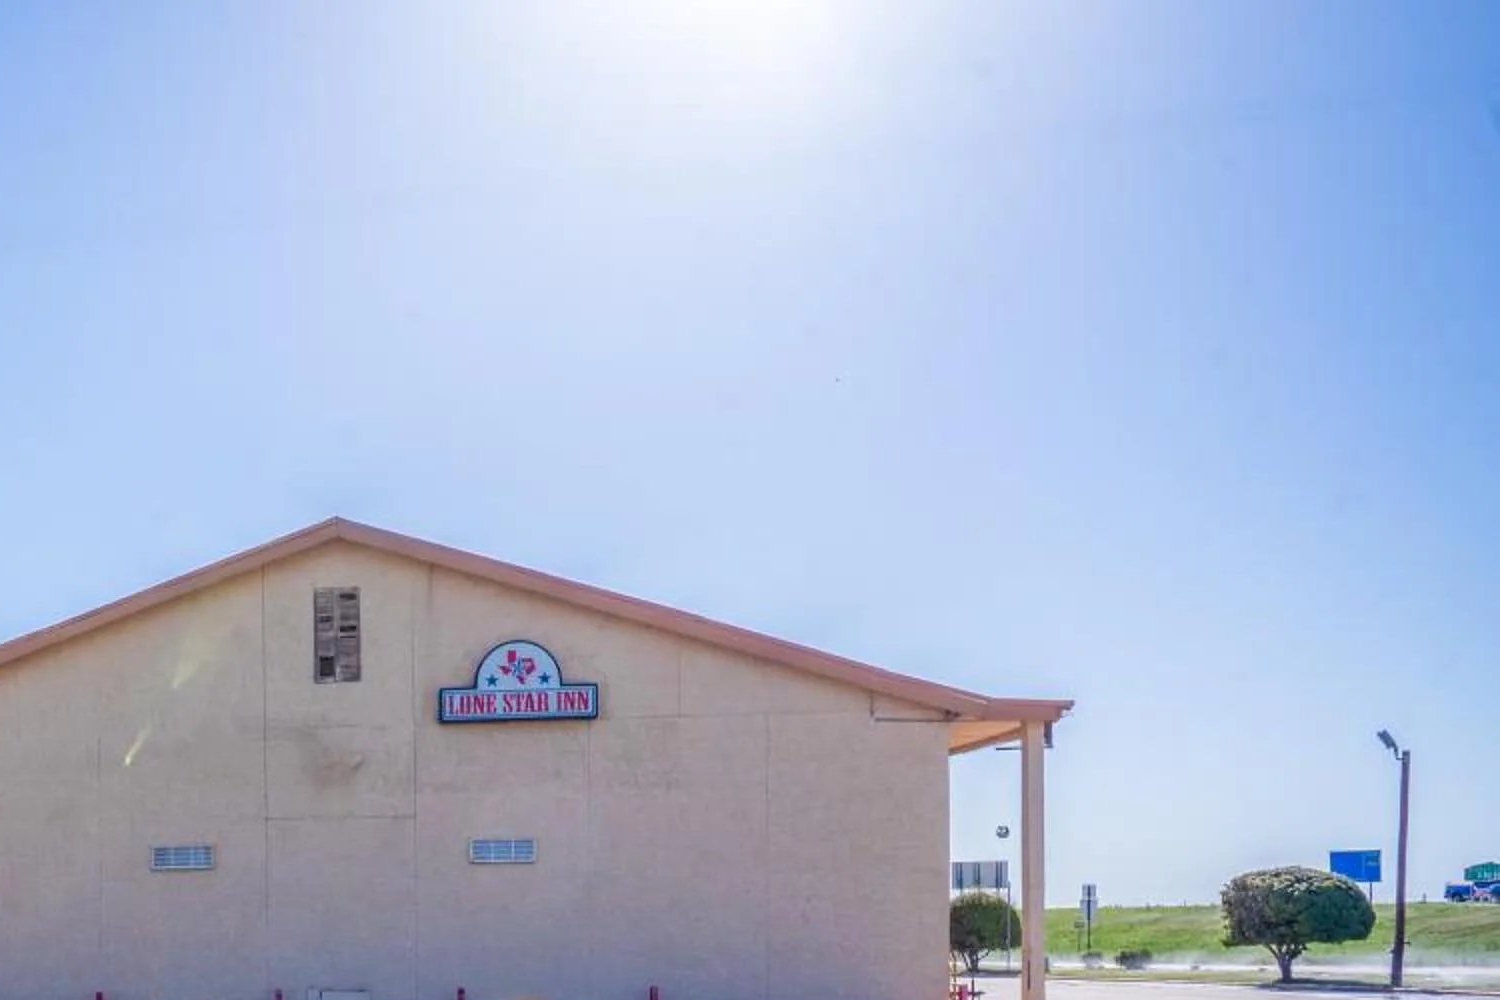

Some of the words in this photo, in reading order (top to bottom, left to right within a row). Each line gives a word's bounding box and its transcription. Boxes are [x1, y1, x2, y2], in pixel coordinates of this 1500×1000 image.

[448, 694, 497, 715] LONE
[503, 691, 549, 713] STAR
[556, 689, 590, 711] INN
